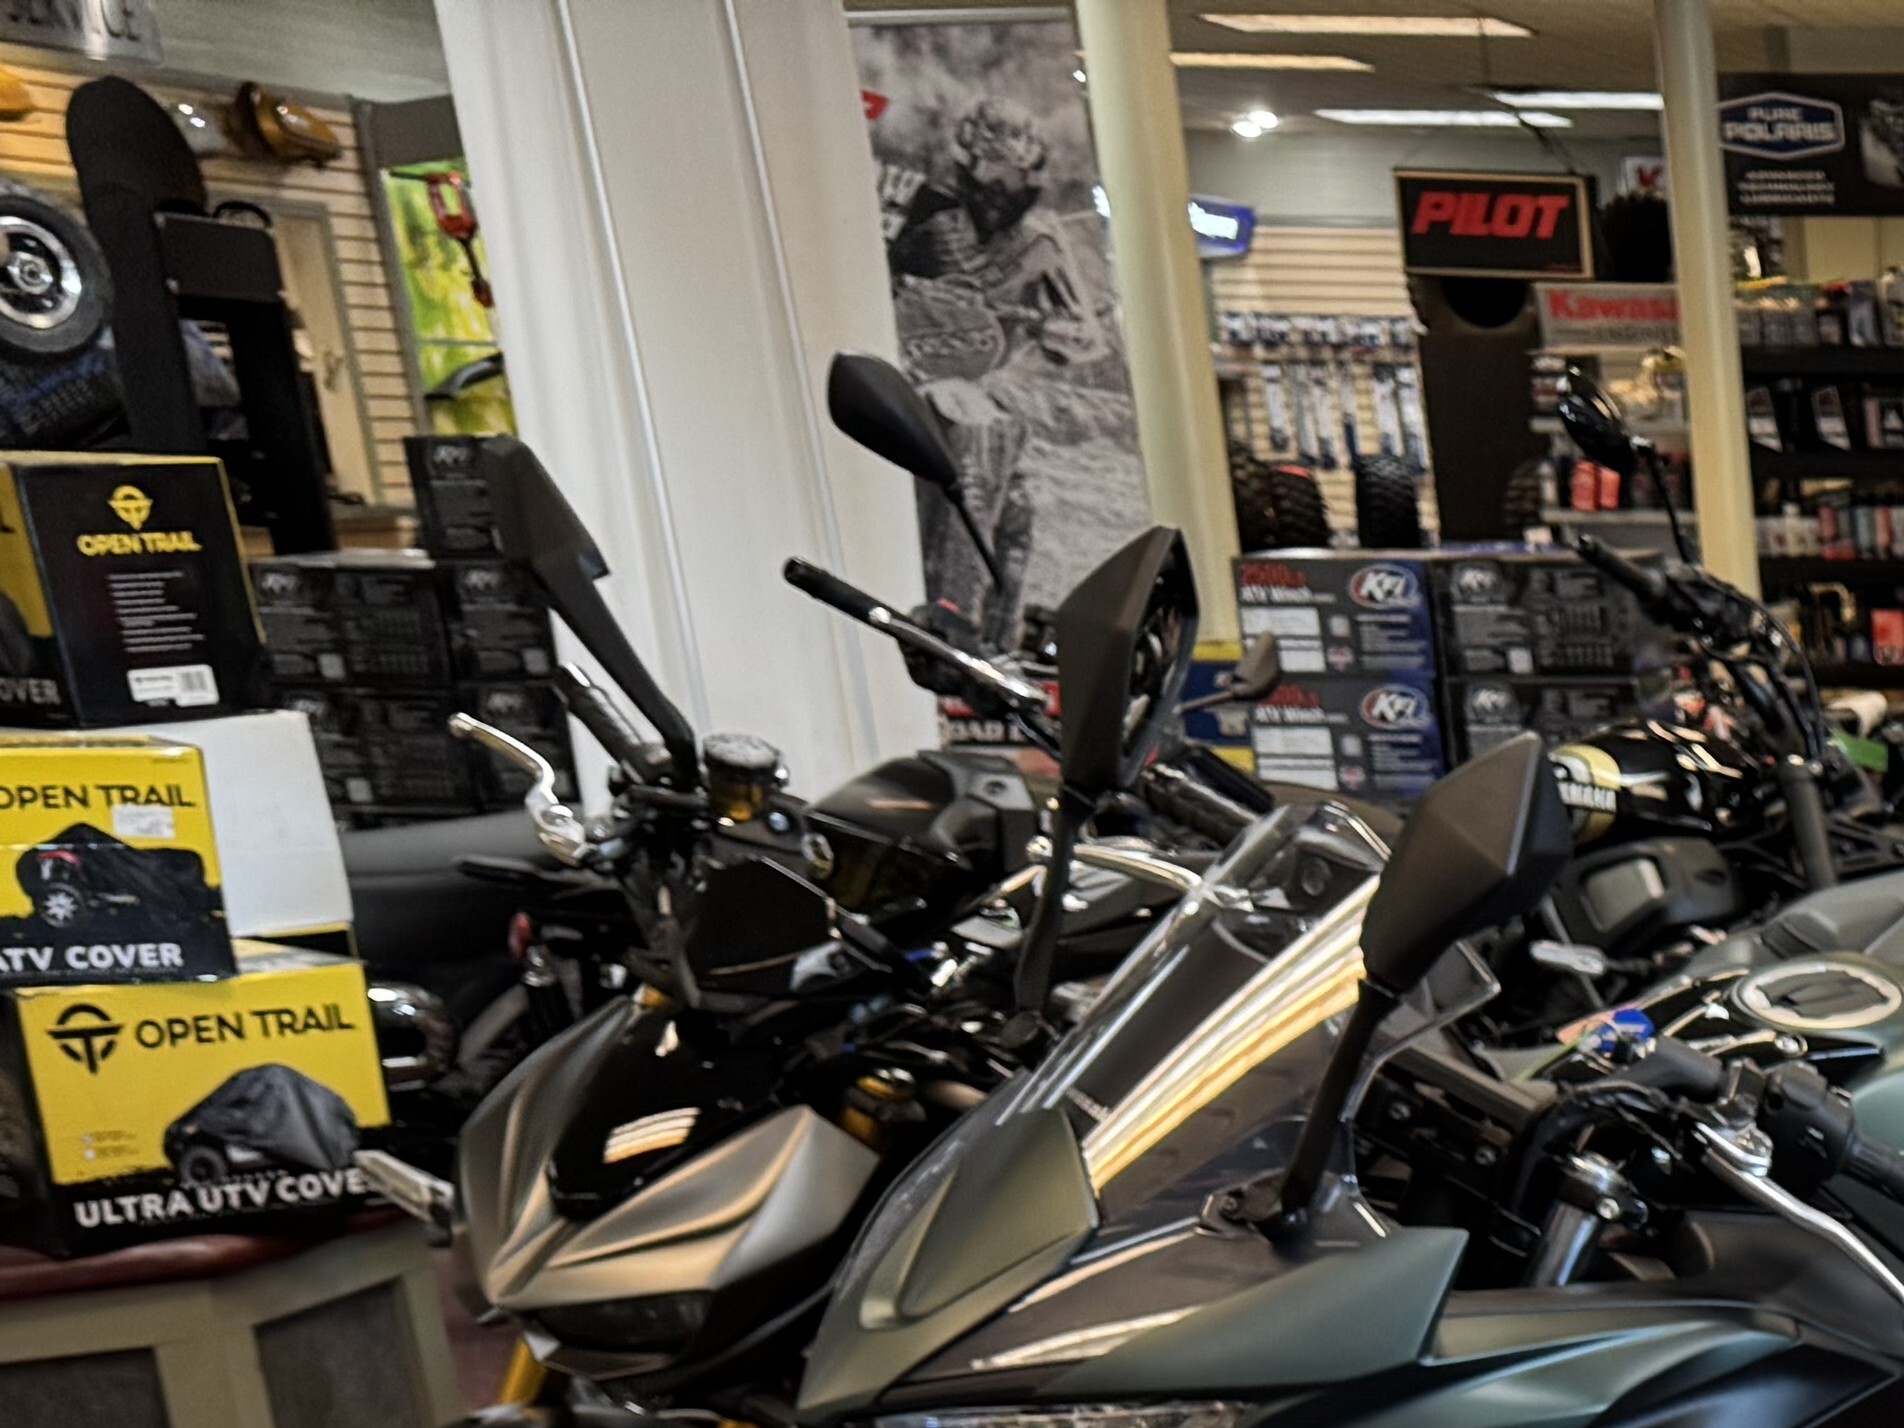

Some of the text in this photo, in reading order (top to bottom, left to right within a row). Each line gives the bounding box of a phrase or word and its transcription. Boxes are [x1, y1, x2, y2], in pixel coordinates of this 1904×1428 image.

[1412, 191, 1571, 240] PILOT
[77, 531, 203, 556] OPEN TRAIL
[0, 677, 61, 703] OVER
[0, 783, 196, 811] OPEN TRAIL
[65, 943, 184, 969] COVER
[135, 1004, 354, 1050] OPEN TRAIL
[75, 1189, 193, 1228] ULTRA
[200, 1182, 273, 1216] UTV
